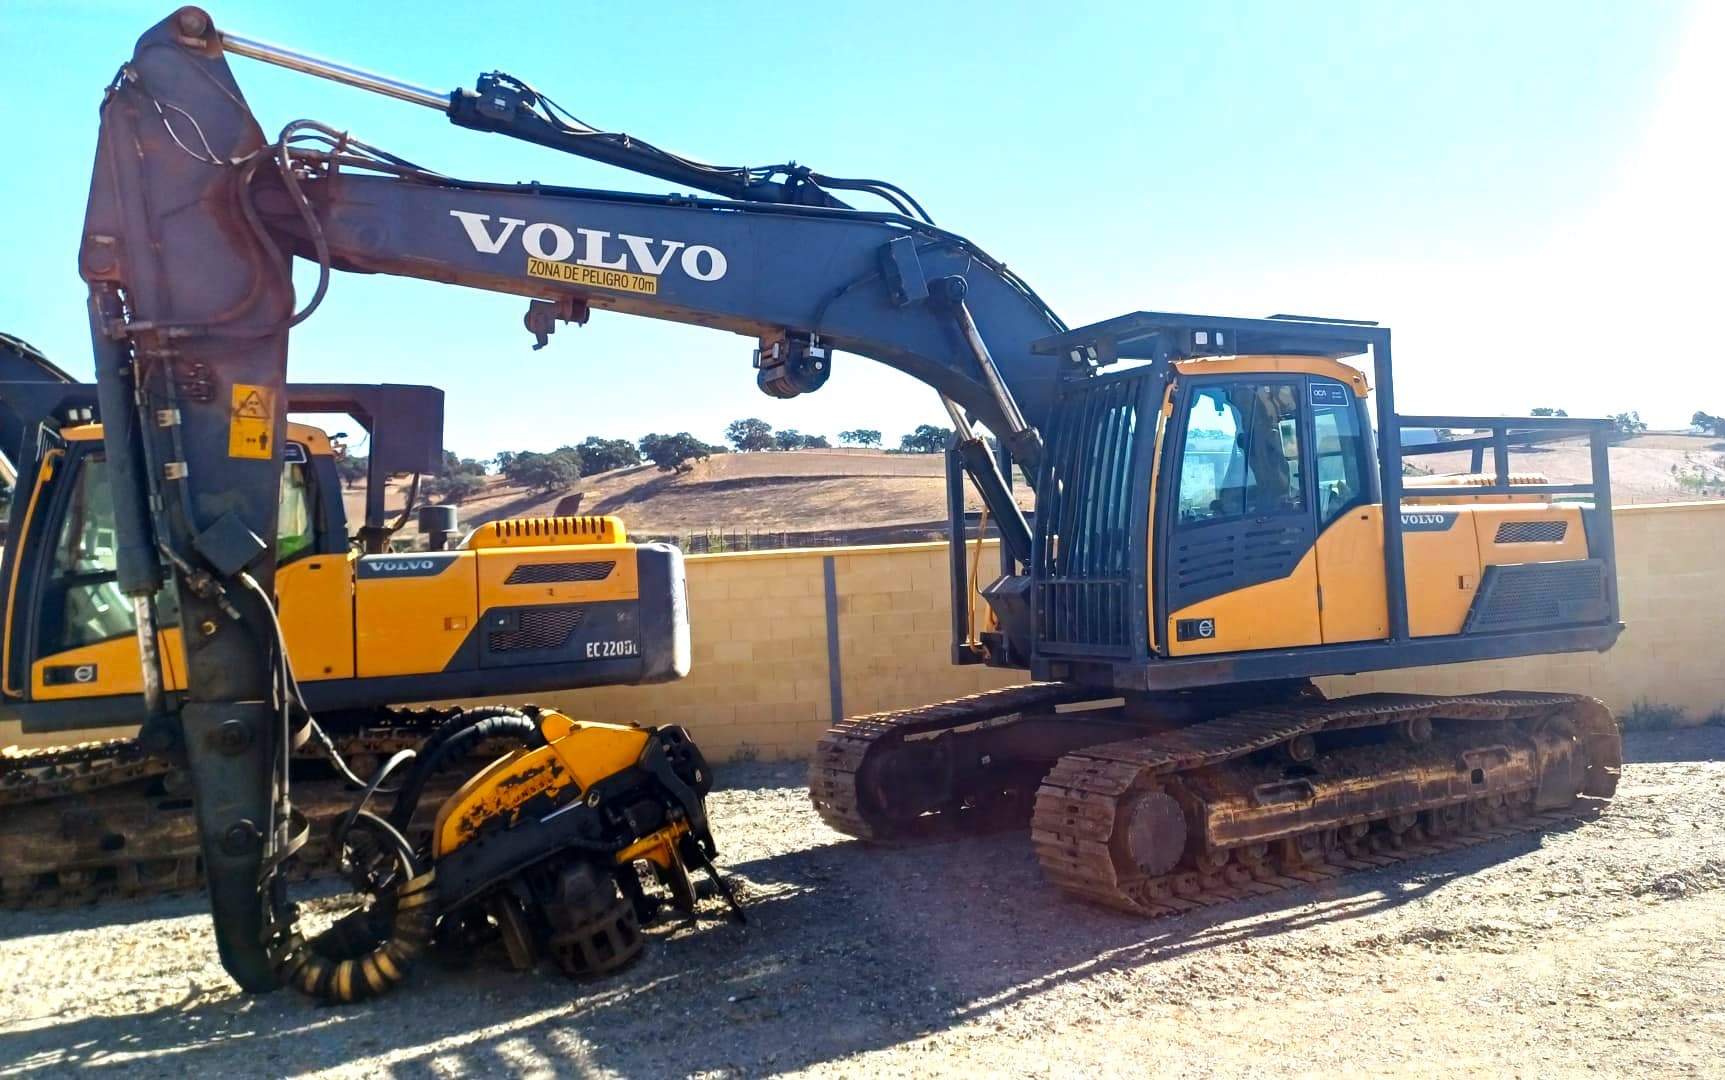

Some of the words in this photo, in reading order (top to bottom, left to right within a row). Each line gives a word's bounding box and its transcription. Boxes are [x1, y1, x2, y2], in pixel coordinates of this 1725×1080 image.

[450, 210, 727, 281] VOLVO
[529, 259, 561, 279] ZONA
[563, 265, 580, 281] DE
[582, 268, 629, 289] PELIGRO
[631, 276, 655, 293] 70m
[1401, 514, 1444, 524] VOLVO
[368, 560, 434, 571] VOLVO
